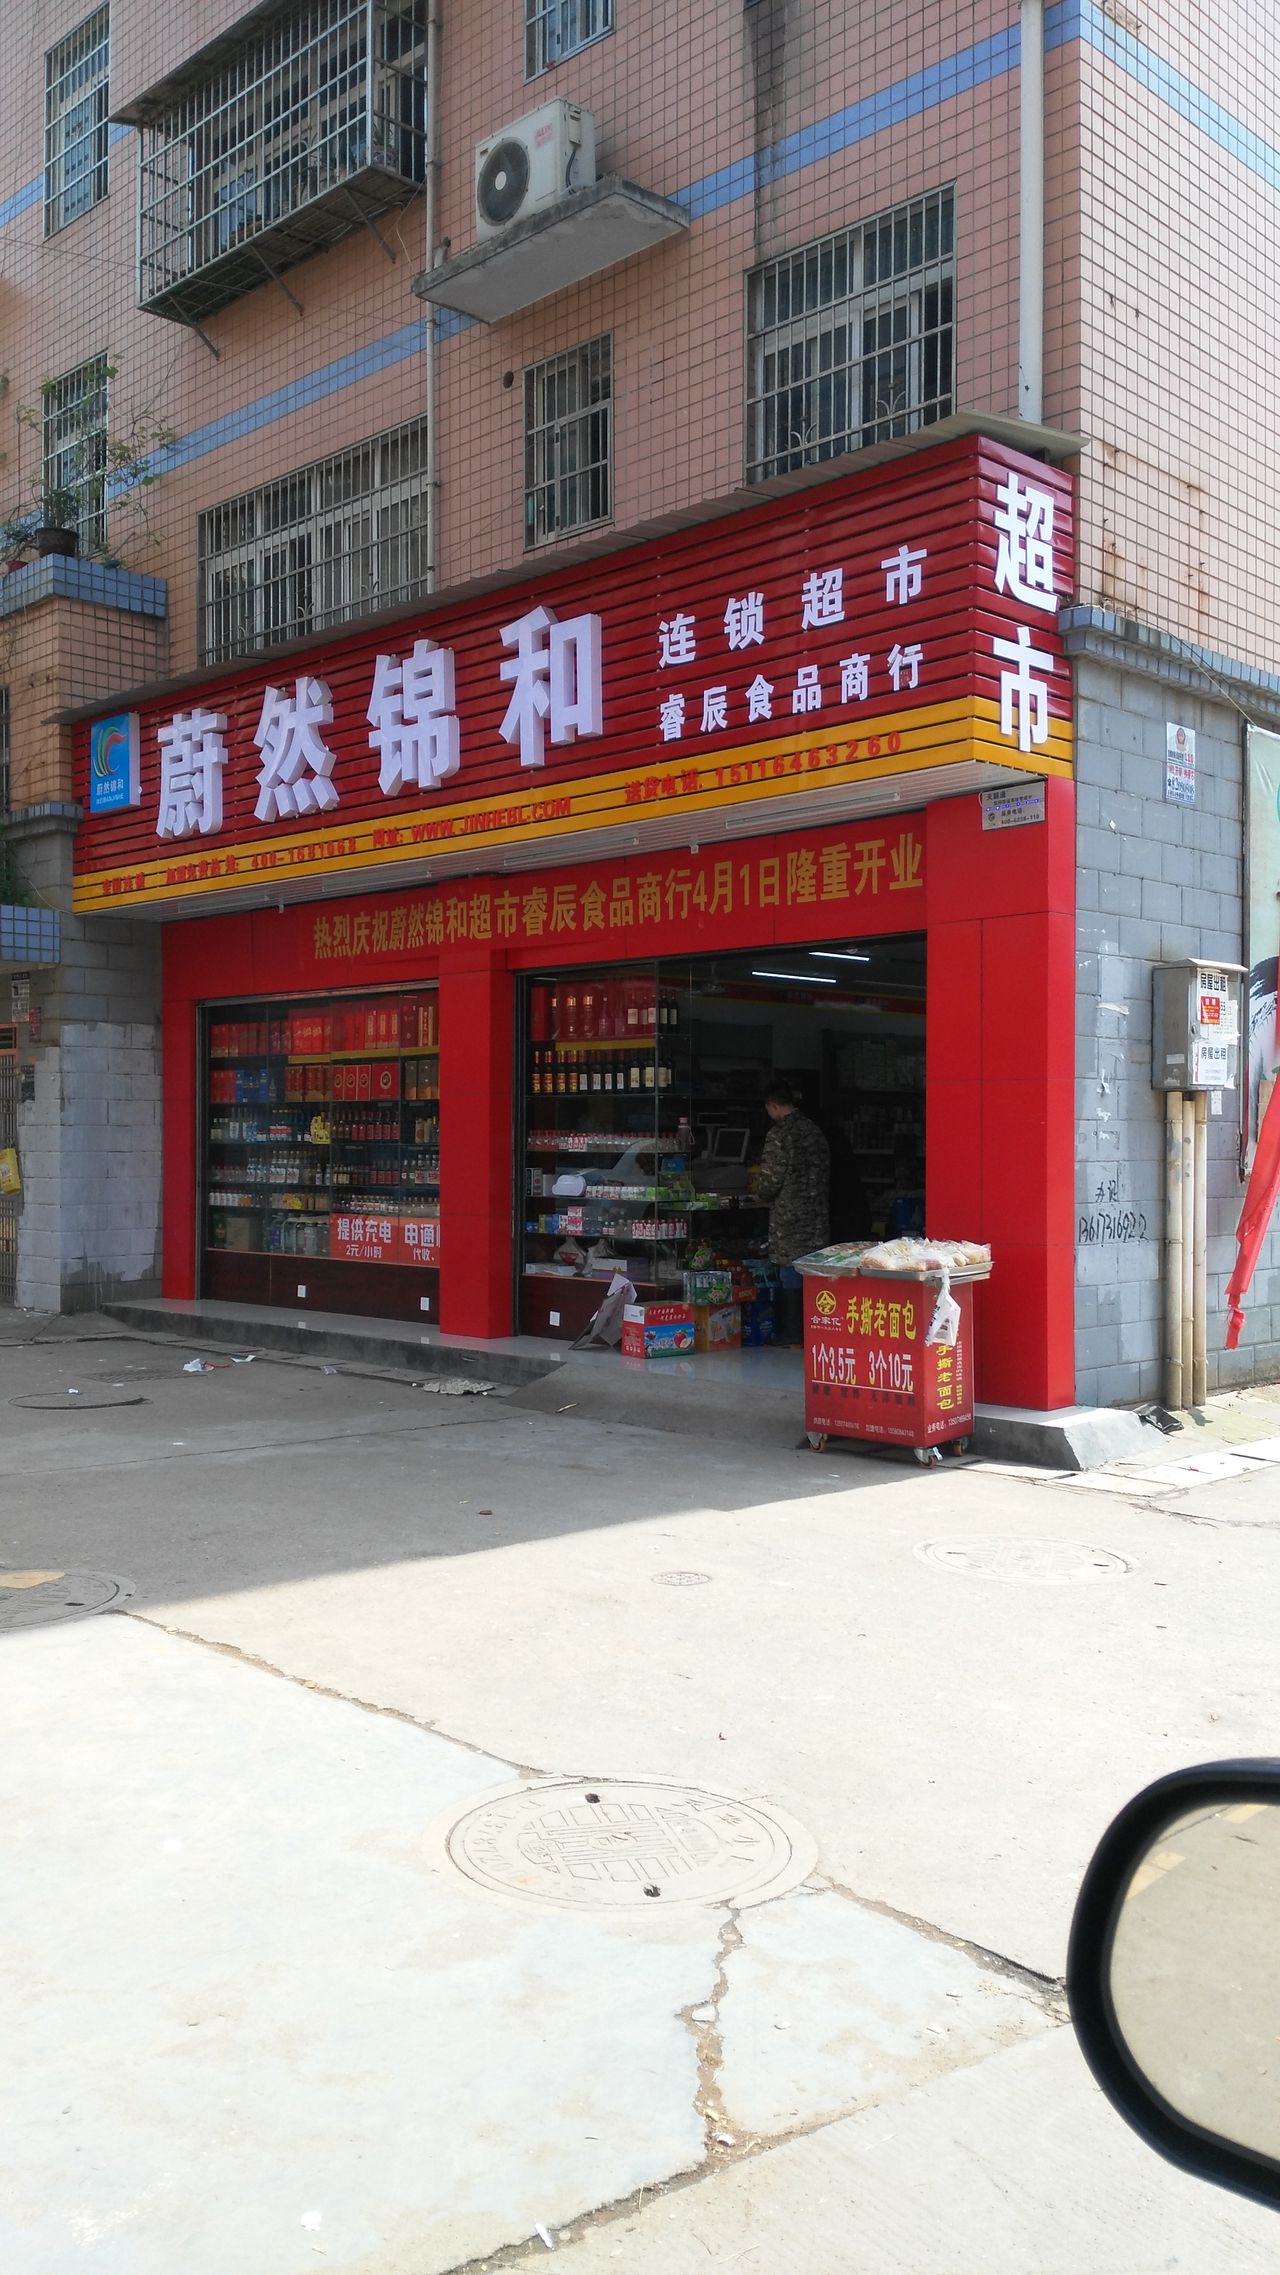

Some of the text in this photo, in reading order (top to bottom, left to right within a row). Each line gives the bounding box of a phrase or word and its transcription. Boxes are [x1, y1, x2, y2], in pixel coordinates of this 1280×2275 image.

[658, 545, 928, 668] 连锁超市
[992, 472, 1059, 752] 超市
[156, 605, 604, 839] 蔚然锦和
[659, 643, 924, 741] 睿辰食品商行
[715, 731, 901, 786] 15116463260
[313, 832, 924, 960] 热烈庆祝蔚然锦和超市睿辰食品商行4月1日隆重开业
[337, 1217, 392, 1243] 提供充电
[846, 1296, 917, 1340] 手撕老面包
[812, 1343, 857, 1385] 1个3.5元
[868, 1349, 914, 1392] 3个10元
